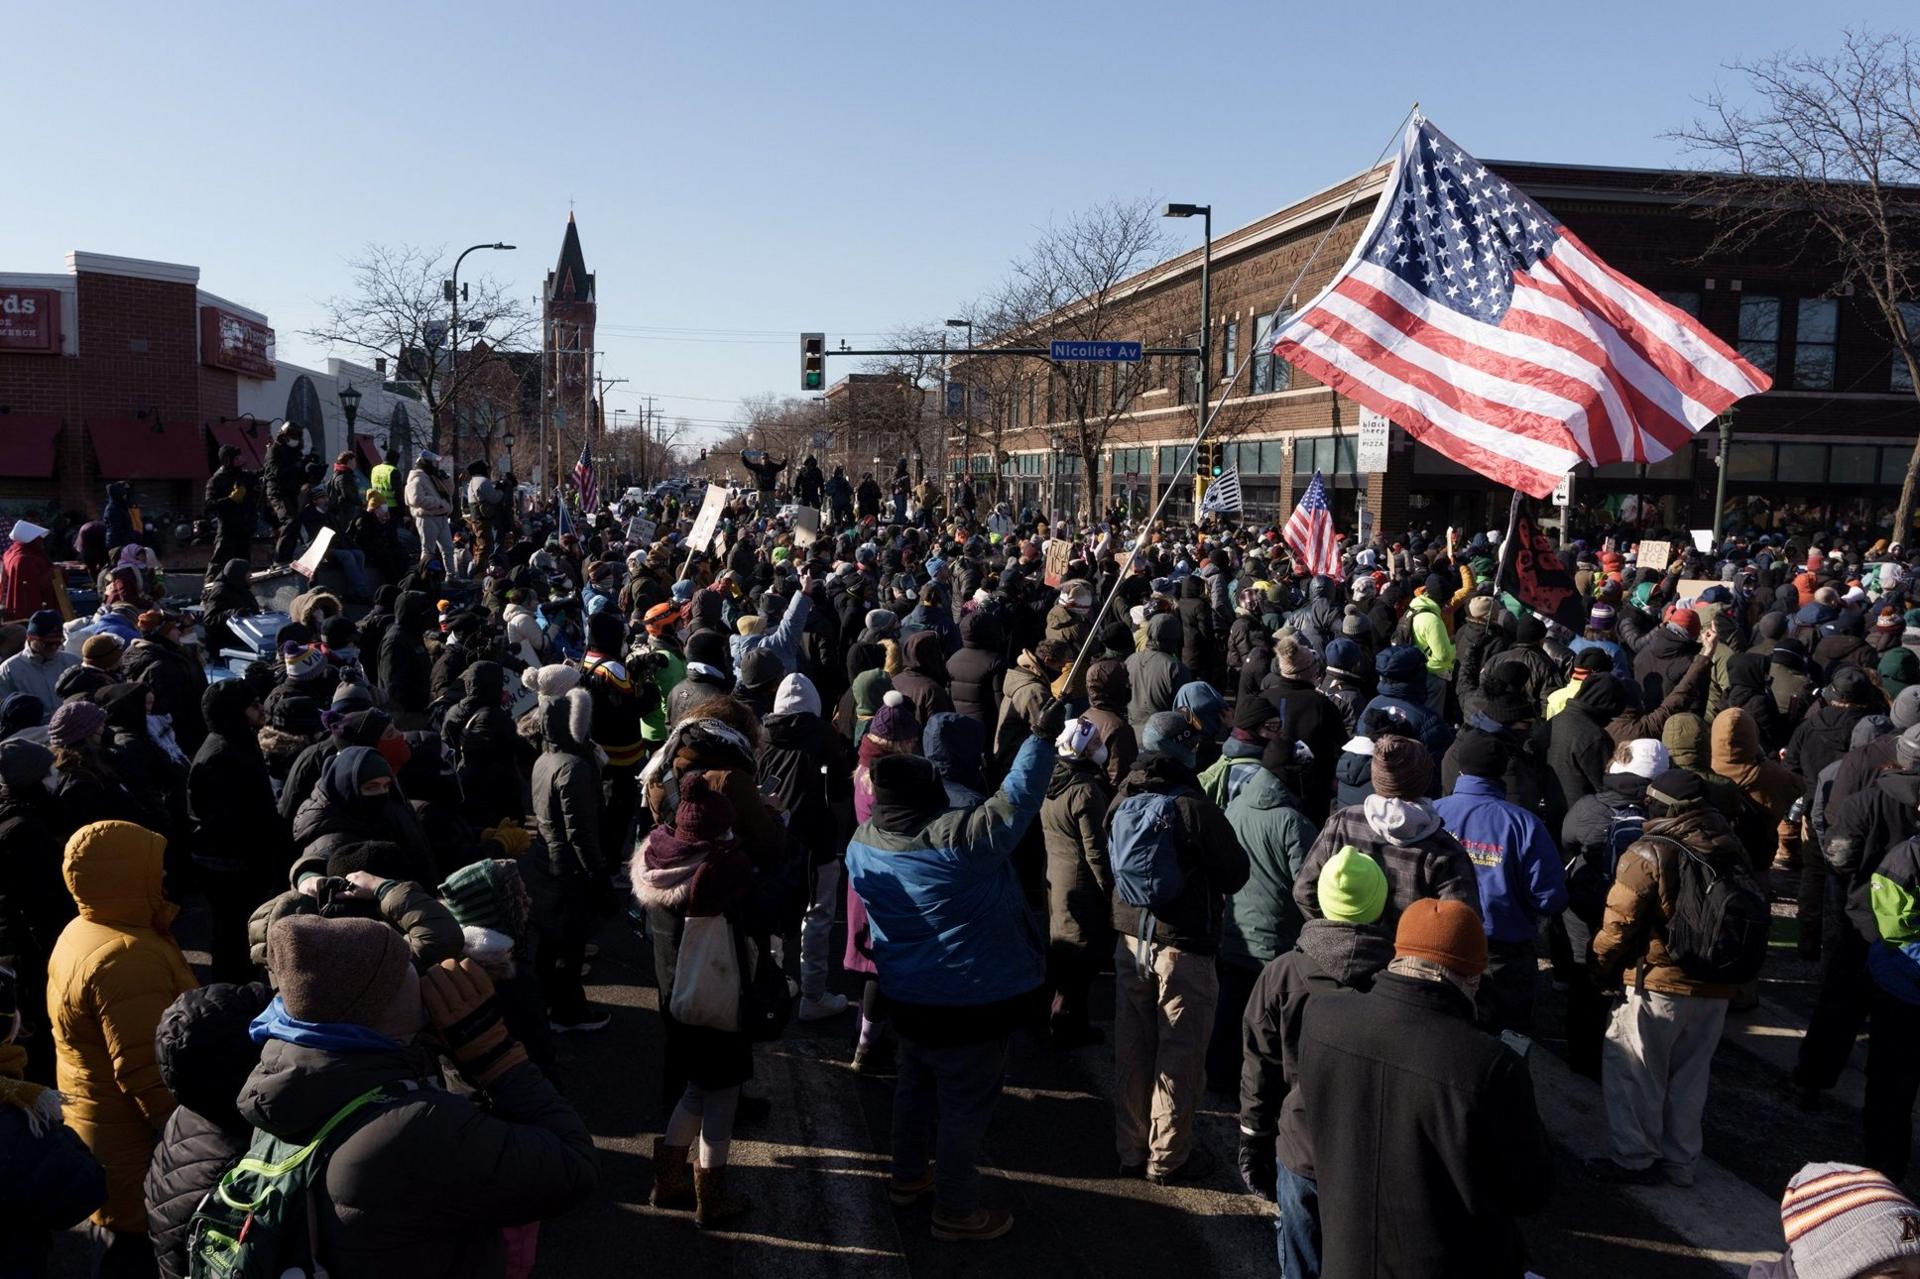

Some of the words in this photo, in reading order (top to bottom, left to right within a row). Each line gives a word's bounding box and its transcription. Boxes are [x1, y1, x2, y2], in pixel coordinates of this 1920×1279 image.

[1055, 344, 1112, 357] Nicollet
[1118, 346, 1137, 357] Av
[1363, 420, 1385, 428] black
[1050, 540, 1070, 561] FUCK
[1641, 542, 1668, 553] FUCK
[1641, 552, 1663, 563] ICE
[1050, 556, 1067, 576] ICE
